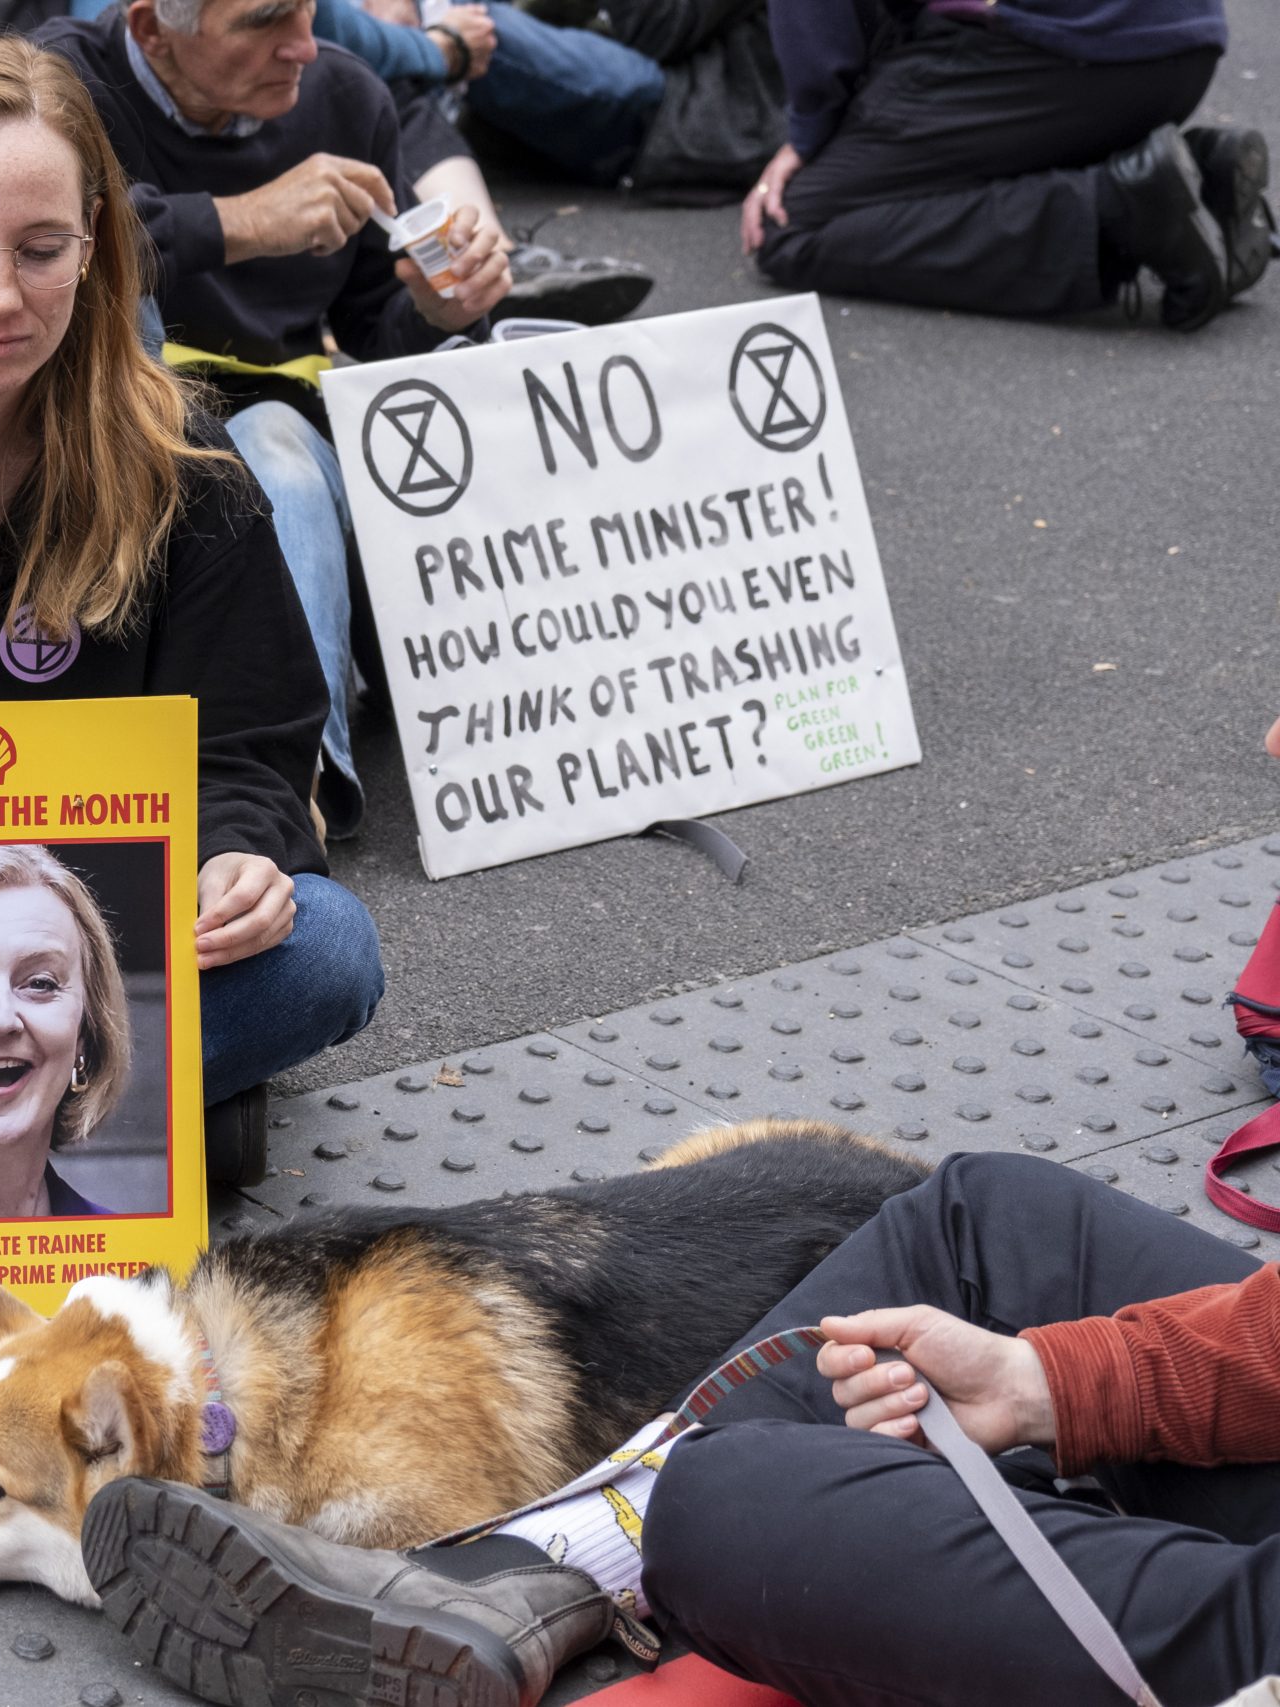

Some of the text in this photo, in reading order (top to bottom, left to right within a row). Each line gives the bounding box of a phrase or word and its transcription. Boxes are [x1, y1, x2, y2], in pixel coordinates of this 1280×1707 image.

[522, 354, 662, 475] NO
[415, 452, 839, 605] PRIME MINISTER!
[403, 549, 855, 680] HOW COULD YOU EVEN
[418, 615, 862, 755] THINK OF TRASHING
[774, 675, 860, 710] PLAN FOR
[786, 705, 841, 732] GREEN
[804, 722, 860, 751] GREEN
[435, 699, 768, 833] OUR PLANET?
[820, 720, 889, 773] GREEN!
[60, 793, 170, 825] MONTH
[27, 1233, 106, 1255] TRAINEE
